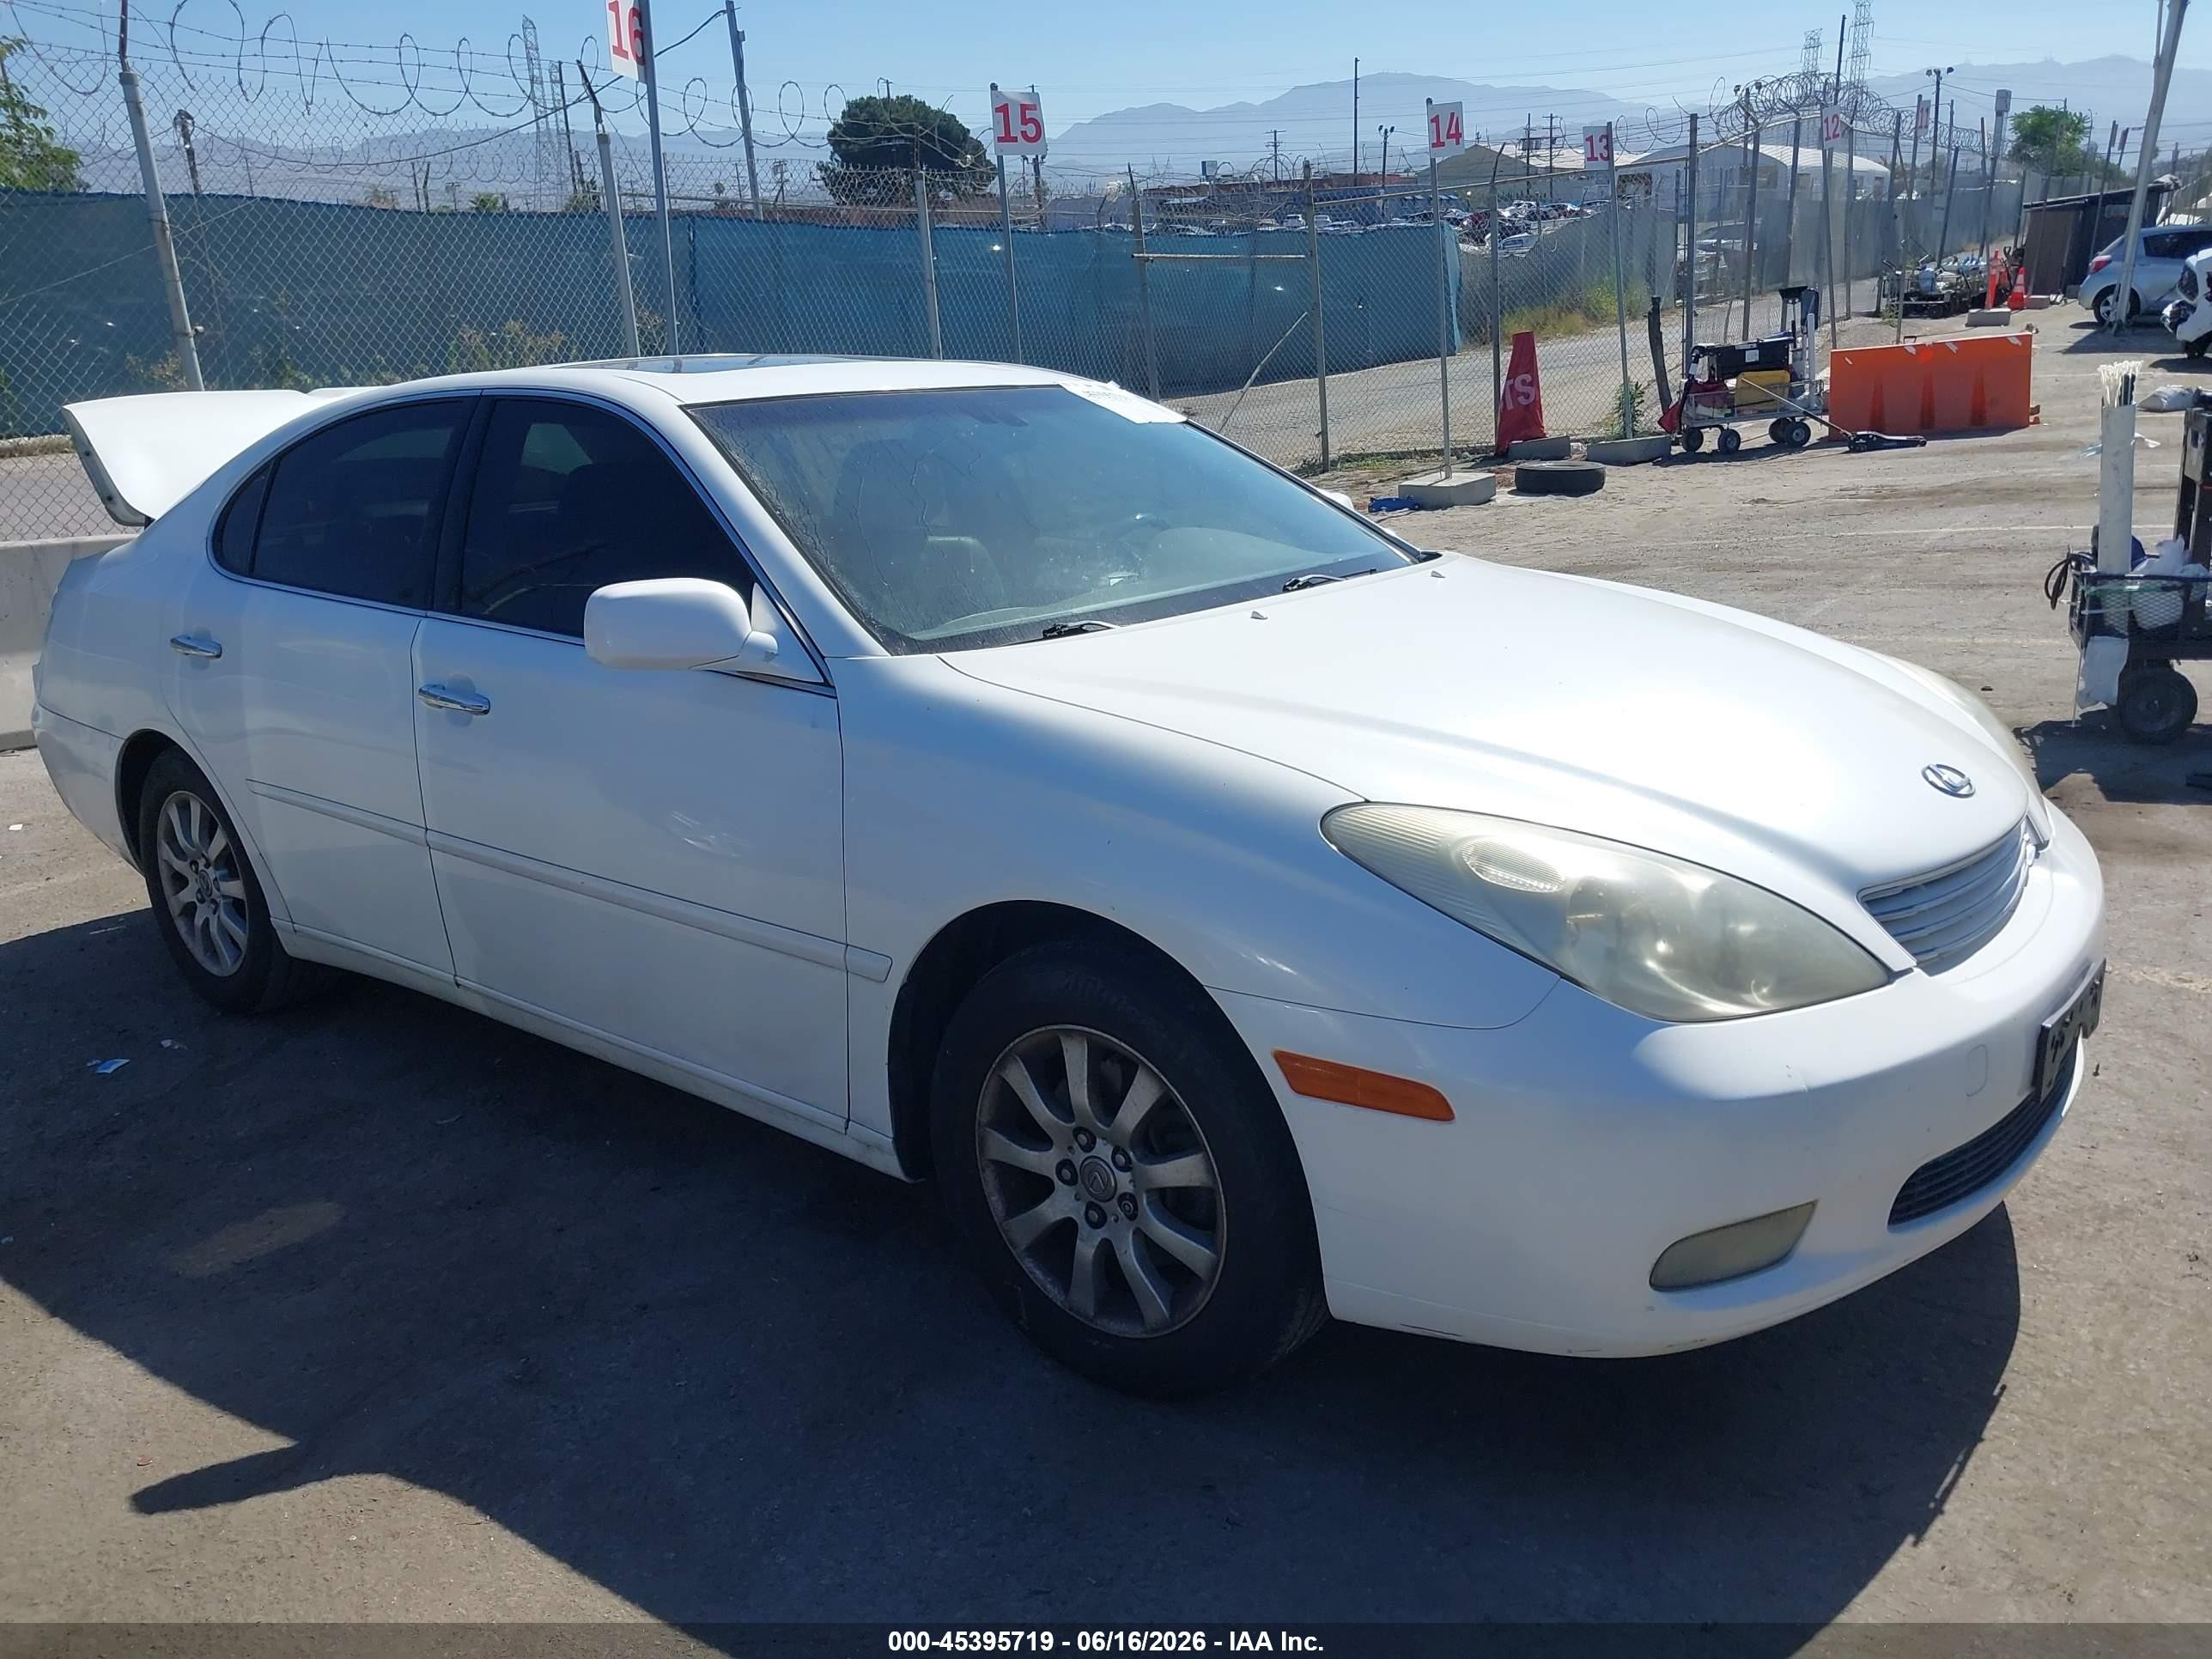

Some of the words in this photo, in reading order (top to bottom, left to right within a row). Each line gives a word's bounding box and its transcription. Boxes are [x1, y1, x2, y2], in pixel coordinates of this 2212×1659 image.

[608, 0, 646, 66] 16
[994, 102, 1042, 143] 15
[1430, 112, 1462, 149] 14
[1824, 113, 1840, 142] 12
[1585, 134, 1609, 162] 13
